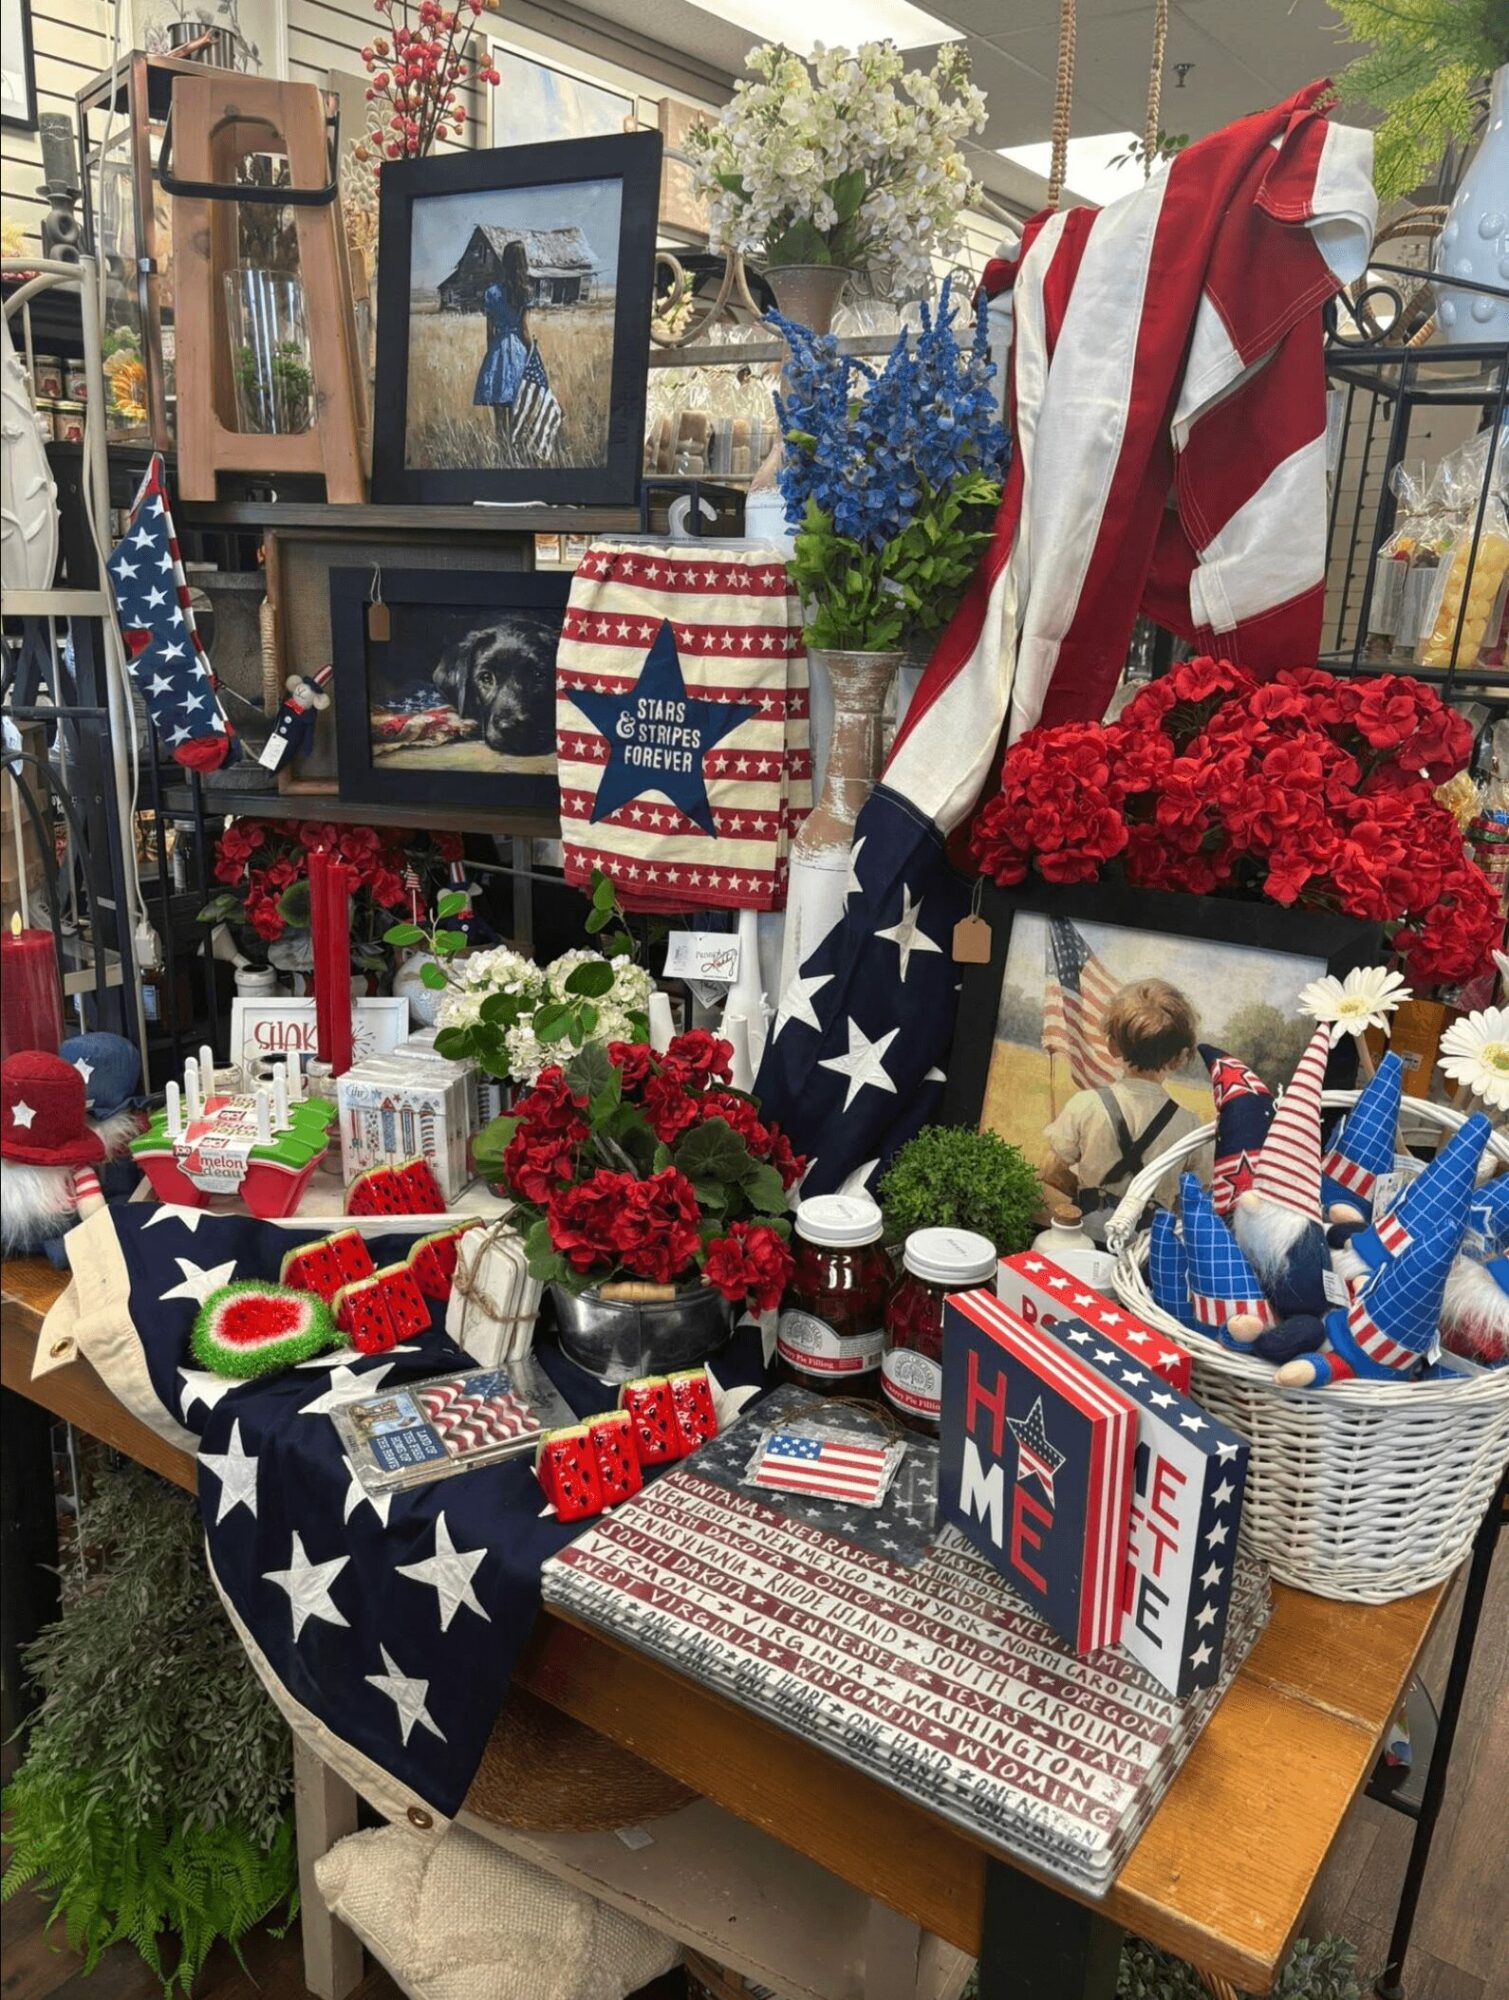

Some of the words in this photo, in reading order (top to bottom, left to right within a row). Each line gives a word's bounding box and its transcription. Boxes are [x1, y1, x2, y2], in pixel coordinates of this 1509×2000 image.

[616, 711, 636, 739] &
[639, 724, 701, 749] STRIPES
[624, 745, 693, 773] FOREVER
[637, 698, 686, 723] STARS
[253, 1020, 317, 1051] SHAK
[201, 1155, 243, 1169] melon
[796, 1354, 807, 1366] Pie
[808, 1357, 834, 1369] Filling
[886, 1381, 904, 1400] Cherry
[905, 1395, 918, 1405] Pie
[918, 1399, 940, 1410] Fillin
[647, 1483, 688, 1507] NEW
[687, 1499, 738, 1526] JERSEY
[755, 1527, 801, 1554] NEW
[799, 1549, 868, 1584] MEXICO
[886, 1586, 932, 1611] NEW
[933, 1602, 986, 1636] YORK
[1000, 1636, 1065, 1671] NORTH
[1065, 1663, 1173, 1724] CAROLINA
[666, 1471, 758, 1518] MONTANA
[779, 1519, 889, 1574] NEBRASKA
[908, 1574, 987, 1616] NEVADA
[1008, 1617, 1060, 1646] NEW
[918, 1560, 1007, 1605] MINNESOTA
[590, 1538, 716, 1603] VERMONT
[742, 1613, 866, 1679] VIRGINIA
[902, 1689, 1096, 1790] WASHINGTON
[600, 1523, 674, 1564] SOUTH
[671, 1556, 747, 1599] DAKOTA
[773, 1603, 906, 1674] TENNESSEE
[941, 1680, 1024, 1726] TEXAS
[1055, 1735, 1132, 1781] UTAH
[618, 1507, 747, 1575] PENNSYLVANIA
[764, 1572, 829, 1611] RHODE
[825, 1602, 898, 1643] ISLAND
[921, 1647, 1010, 1697] SOUTH
[1018, 1689, 1143, 1762] CAROLINA
[639, 1500, 701, 1528] NORTH
[705, 1526, 786, 1567] DAKOTA
[814, 1574, 872, 1605] OHIO
[899, 1612, 1031, 1682] OKLAHOMA
[1060, 1685, 1160, 1741] OREGON
[574, 1555, 644, 1590] WEST
[651, 1588, 762, 1653] VIRGINIA
[794, 1658, 926, 1732] WISCONSIN
[955, 1739, 1112, 1826] WYOMING
[585, 1578, 628, 1606] FLAG
[642, 1611, 680, 1632] ONE
[680, 1627, 725, 1656] LAND
[737, 1658, 777, 1682] ONE
[777, 1673, 832, 1708] HEART
[847, 1712, 893, 1738] ONE
[892, 1733, 953, 1772] HAND
[975, 1778, 1017, 1803] ONE
[1016, 1796, 1099, 1846] NATION
